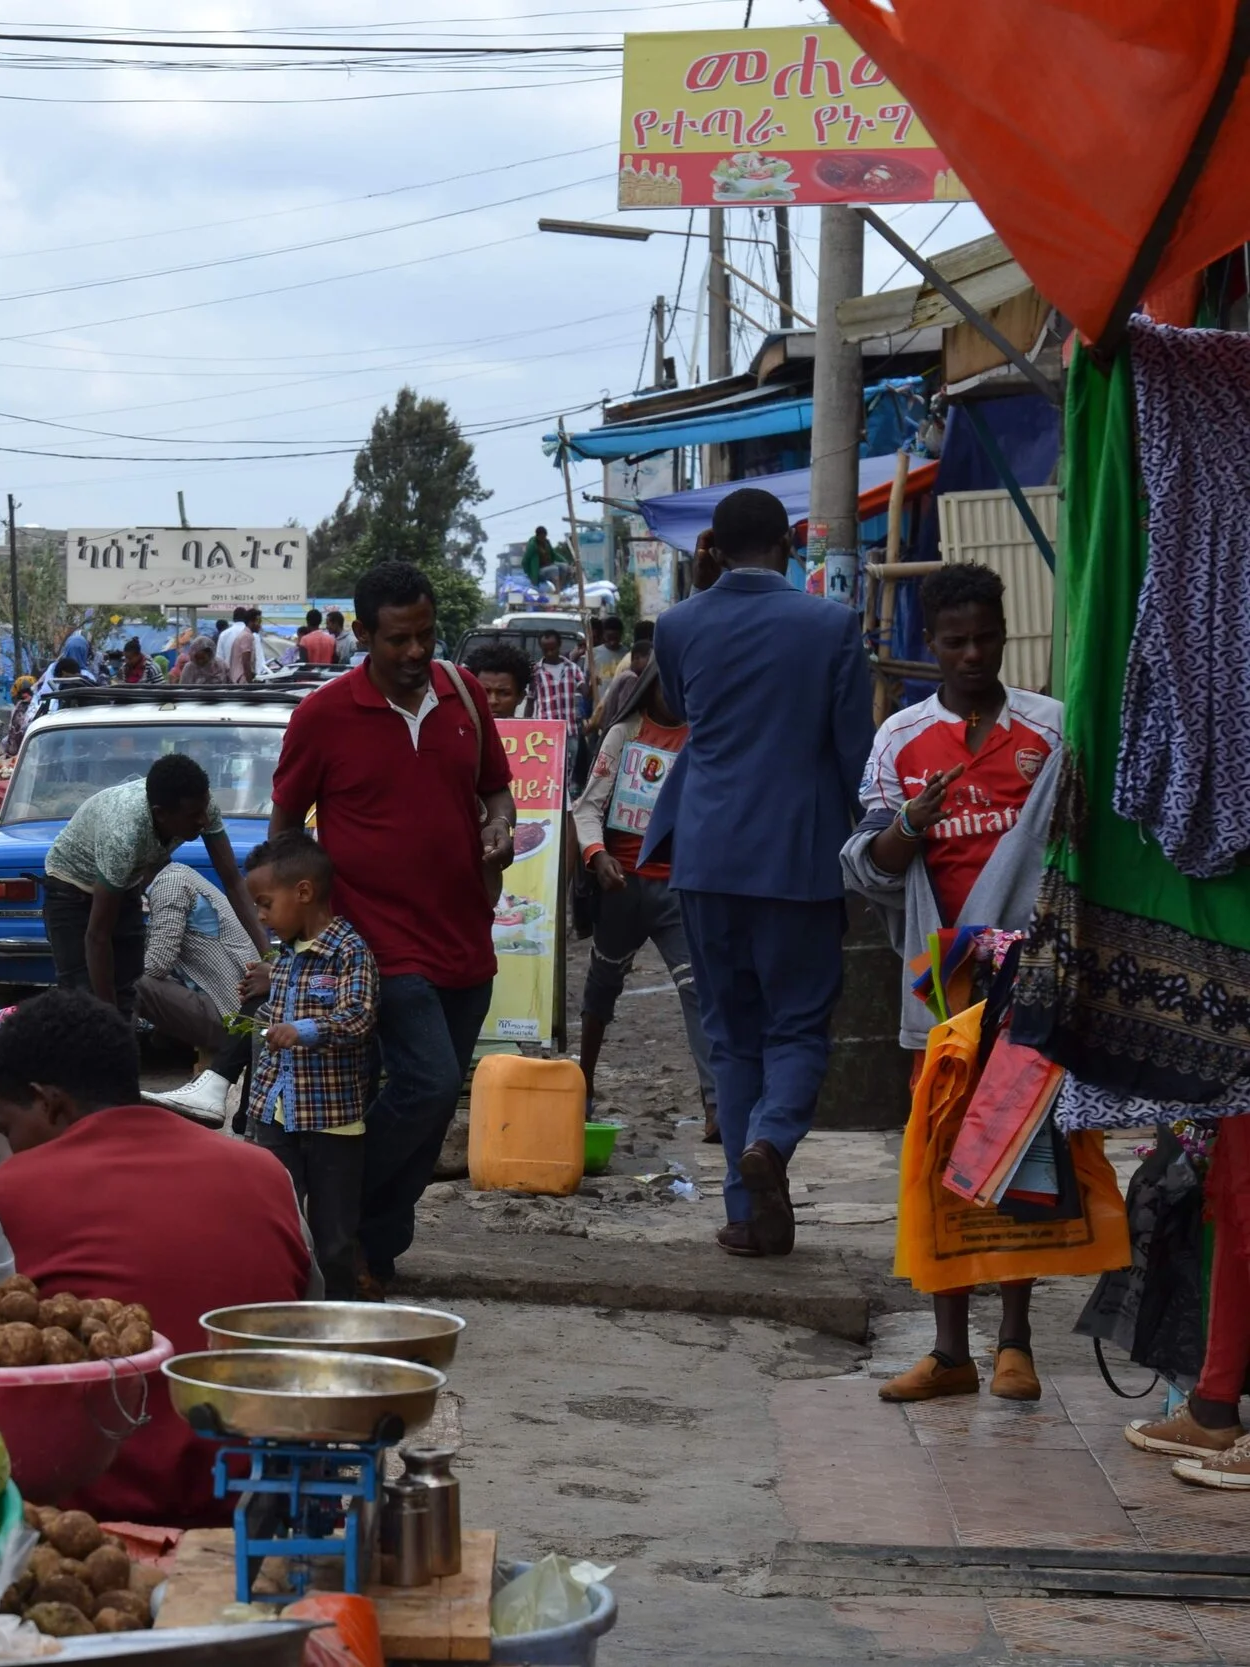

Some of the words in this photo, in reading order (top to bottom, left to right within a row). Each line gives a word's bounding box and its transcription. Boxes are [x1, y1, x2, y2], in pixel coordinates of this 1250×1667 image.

[633, 107, 786, 148] የተጣራ
[813, 103, 915, 145] የኑግ
[181, 535, 299, 570] ባልትና
[508, 775, 560, 802] ዘይት
